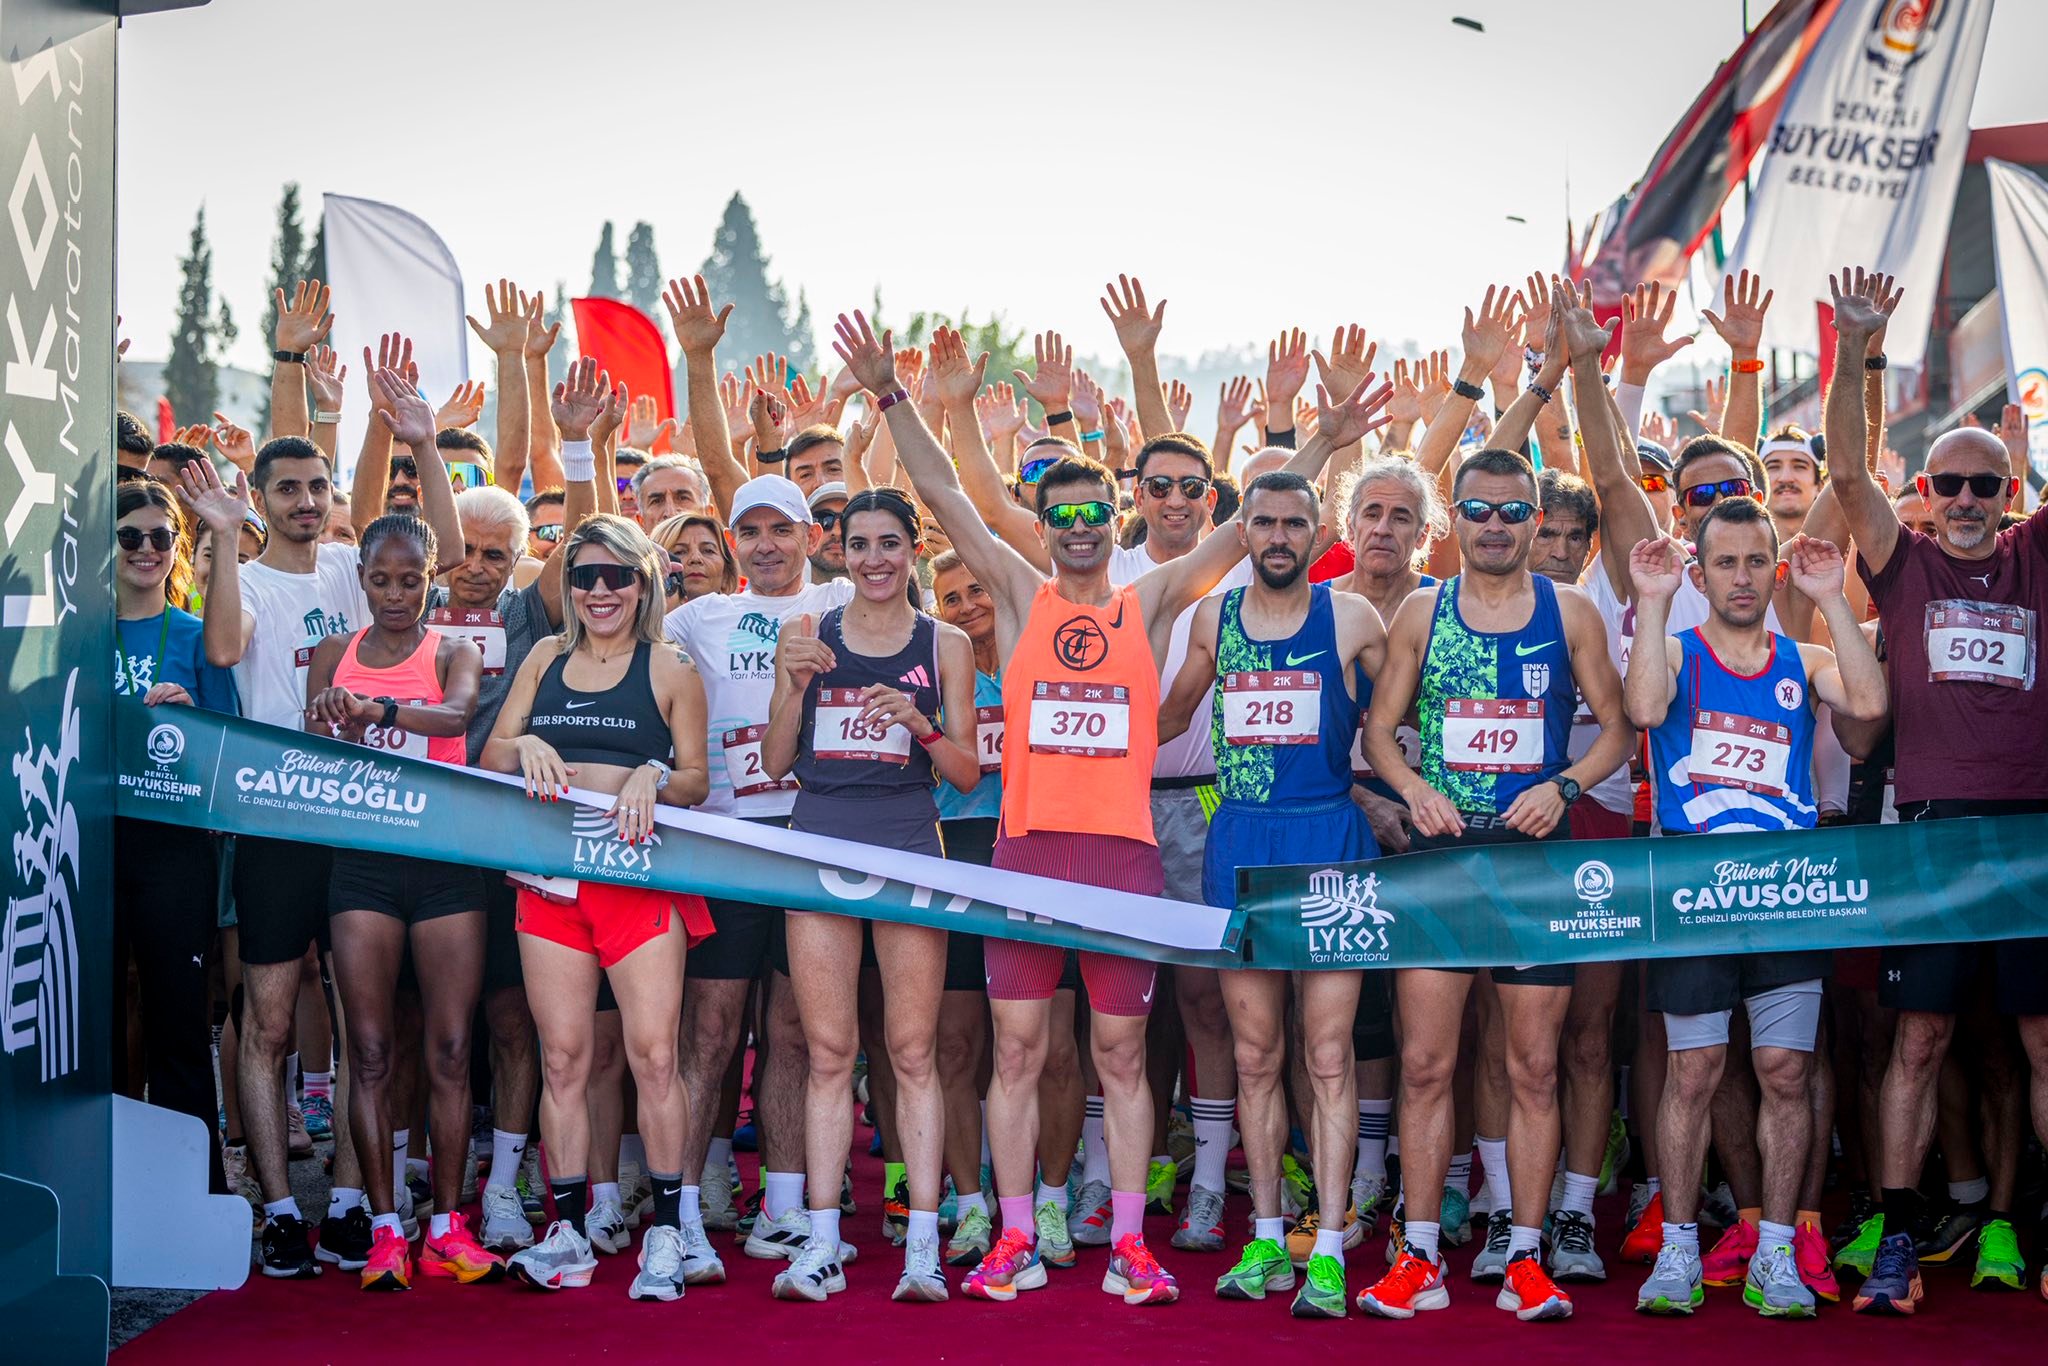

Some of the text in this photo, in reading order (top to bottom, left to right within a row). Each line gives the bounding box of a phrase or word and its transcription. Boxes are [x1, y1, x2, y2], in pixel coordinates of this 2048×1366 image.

[4, 35, 60, 628] LYKOS
[465, 613, 481, 623] 21K
[1984, 617, 2001, 627] 21K
[1947, 637, 2006, 666] 502
[1522, 663, 1550, 671] ENKA
[1273, 676, 1292, 687] 21K
[1084, 688, 1102, 699] 21K
[1245, 700, 1294, 726] 218
[1498, 704, 1516, 715] 21K
[601, 717, 637, 730] CLUB
[1050, 710, 1106, 738] 370
[1749, 723, 1767, 736] 21K
[1467, 728, 1519, 754] 419
[1711, 742, 1766, 773] 273
[275, 749, 401, 788] Bülent Nuri
[235, 767, 427, 815] ÇAVUŞOĞLU
[237, 794, 252, 804] T.C.
[573, 837, 652, 872] LYKOS
[593, 865, 650, 882] Maratonu
[1710, 856, 1838, 887] Bülent Nuri
[1672, 878, 1869, 914] ÇAVUŞOĞLU
[1679, 916, 1694, 925] T.C.
[1308, 926, 1389, 952] LYKOS
[1333, 951, 1390, 963] Maratonu
